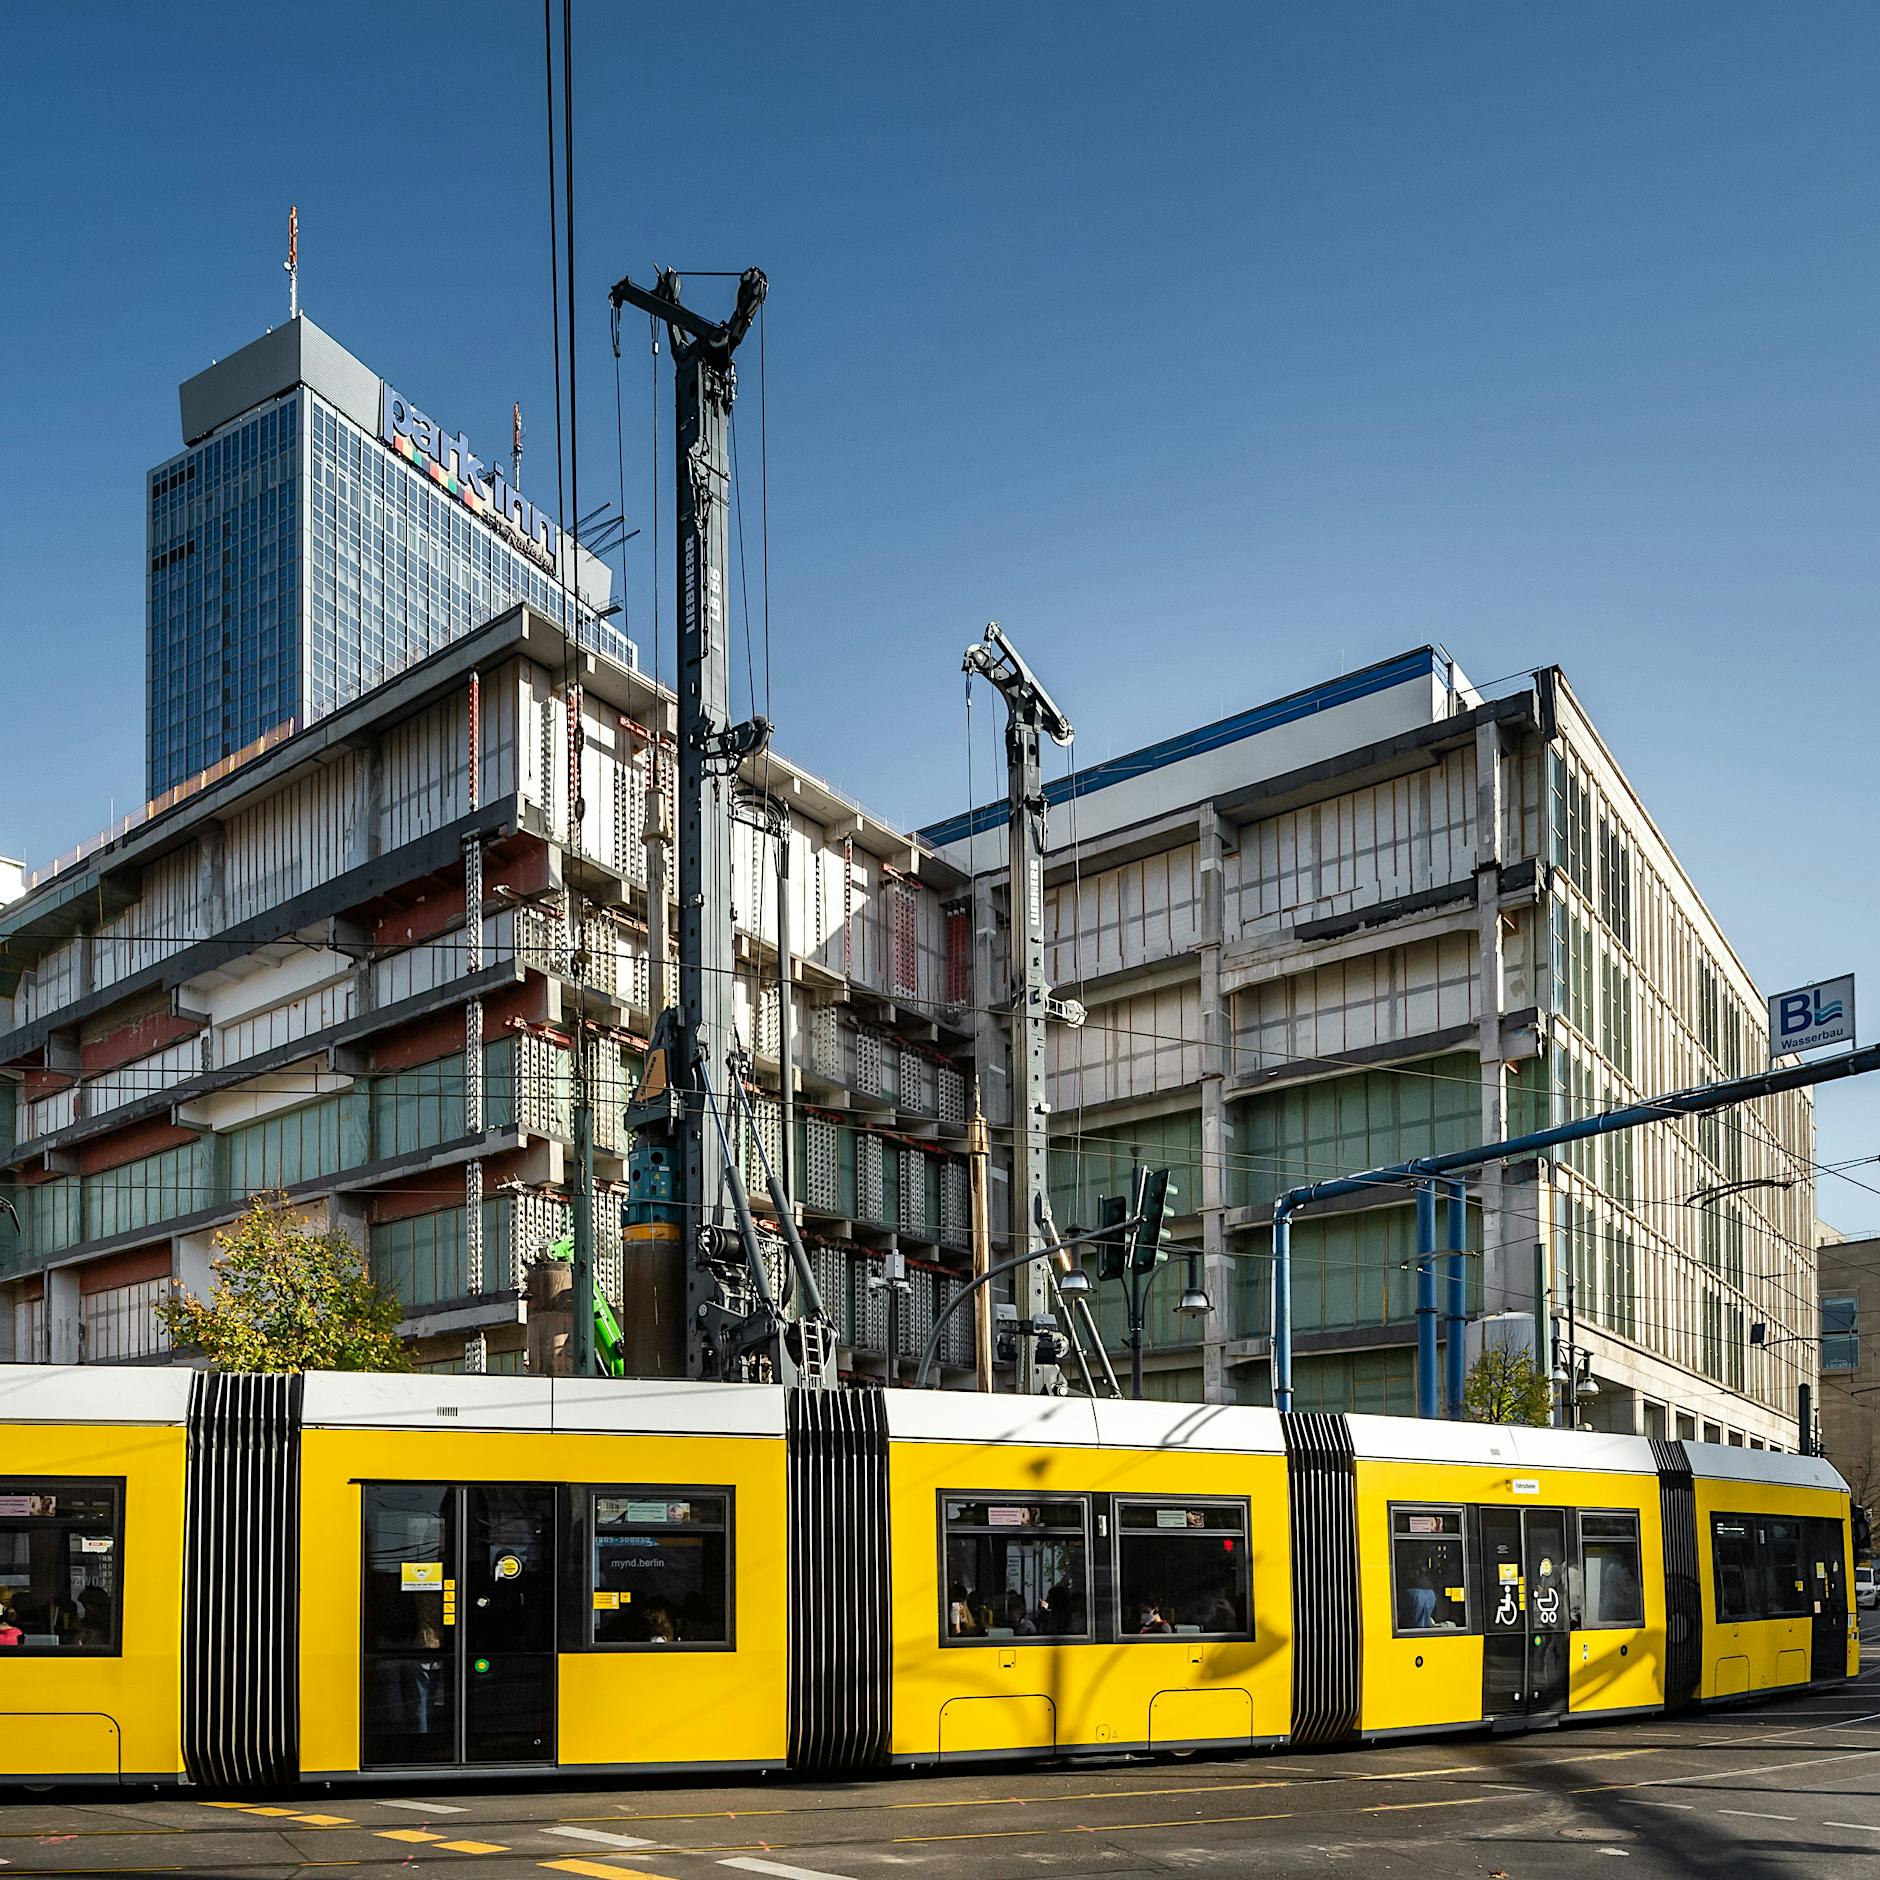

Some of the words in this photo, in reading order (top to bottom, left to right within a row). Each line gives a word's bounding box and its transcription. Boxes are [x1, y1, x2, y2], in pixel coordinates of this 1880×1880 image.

[383, 383, 486, 500] park
[493, 461, 557, 557] inn
[685, 534, 696, 634] LIEBHERR
[1030, 860, 1039, 925] LIEBHERR
[1781, 1028, 1844, 1050] Wasserbau
[611, 1558, 665, 1570] mynd.berlin
